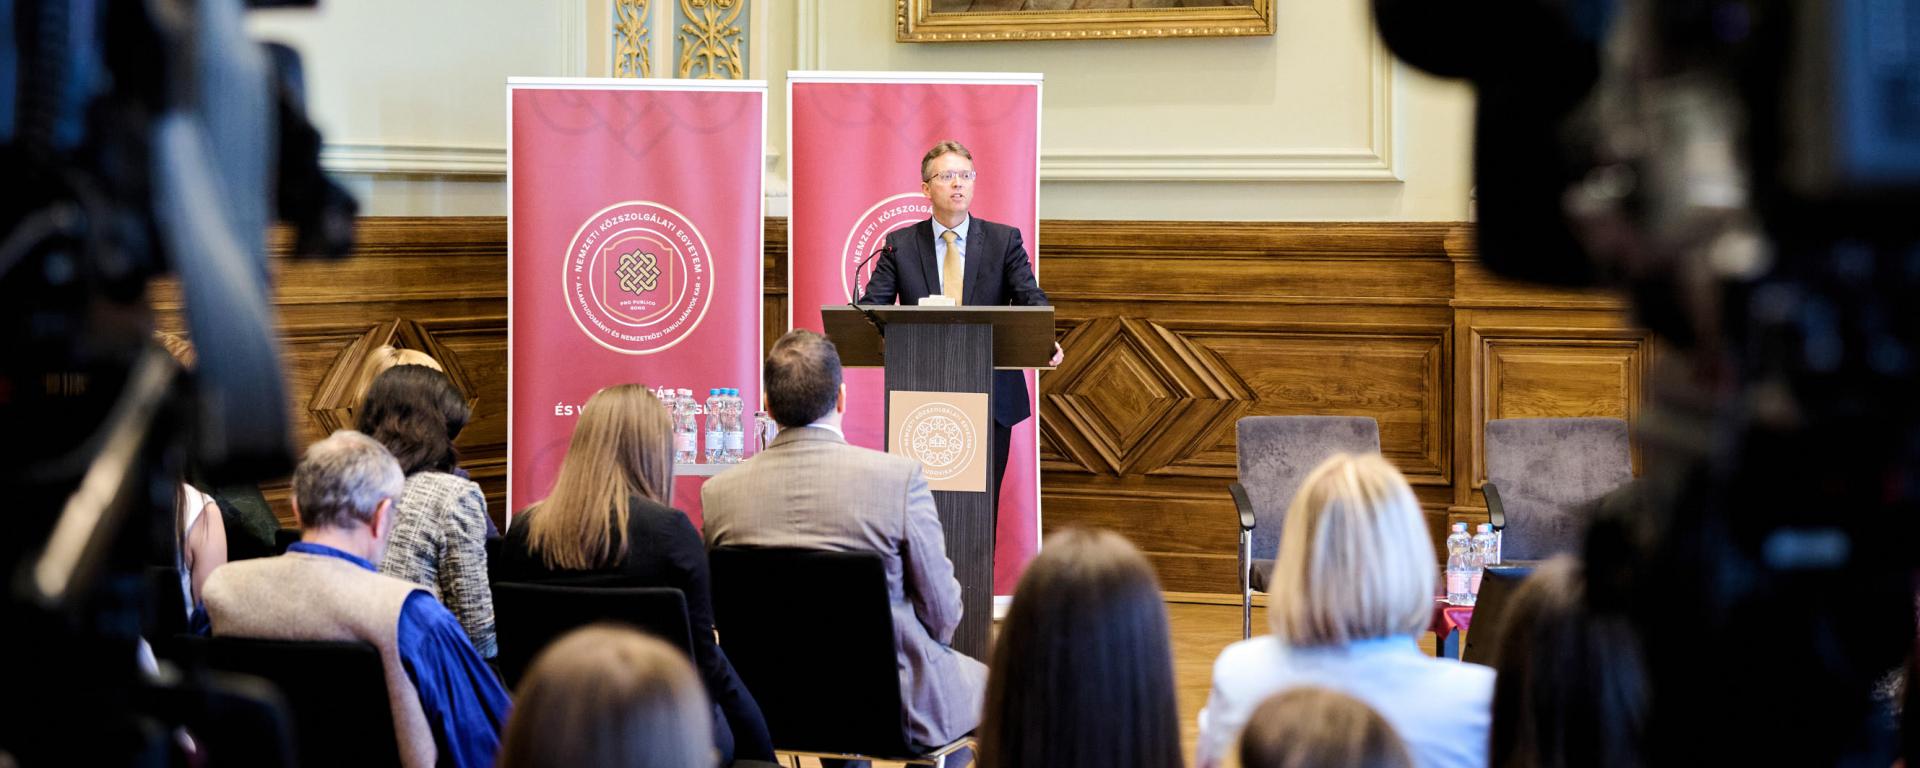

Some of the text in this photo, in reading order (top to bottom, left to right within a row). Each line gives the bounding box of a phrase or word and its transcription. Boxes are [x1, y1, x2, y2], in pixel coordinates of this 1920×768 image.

[575, 213, 702, 273] NEMZETI KÖZSZOLGÁLATI EGYETEM
[854, 222, 878, 264] NEMZETI
[611, 330, 620, 338] ÉS
[620, 331, 663, 342] NEMZETKÖZI
[662, 297, 698, 335] TANULMÁNYOK
[555, 402, 573, 415] ÉS
